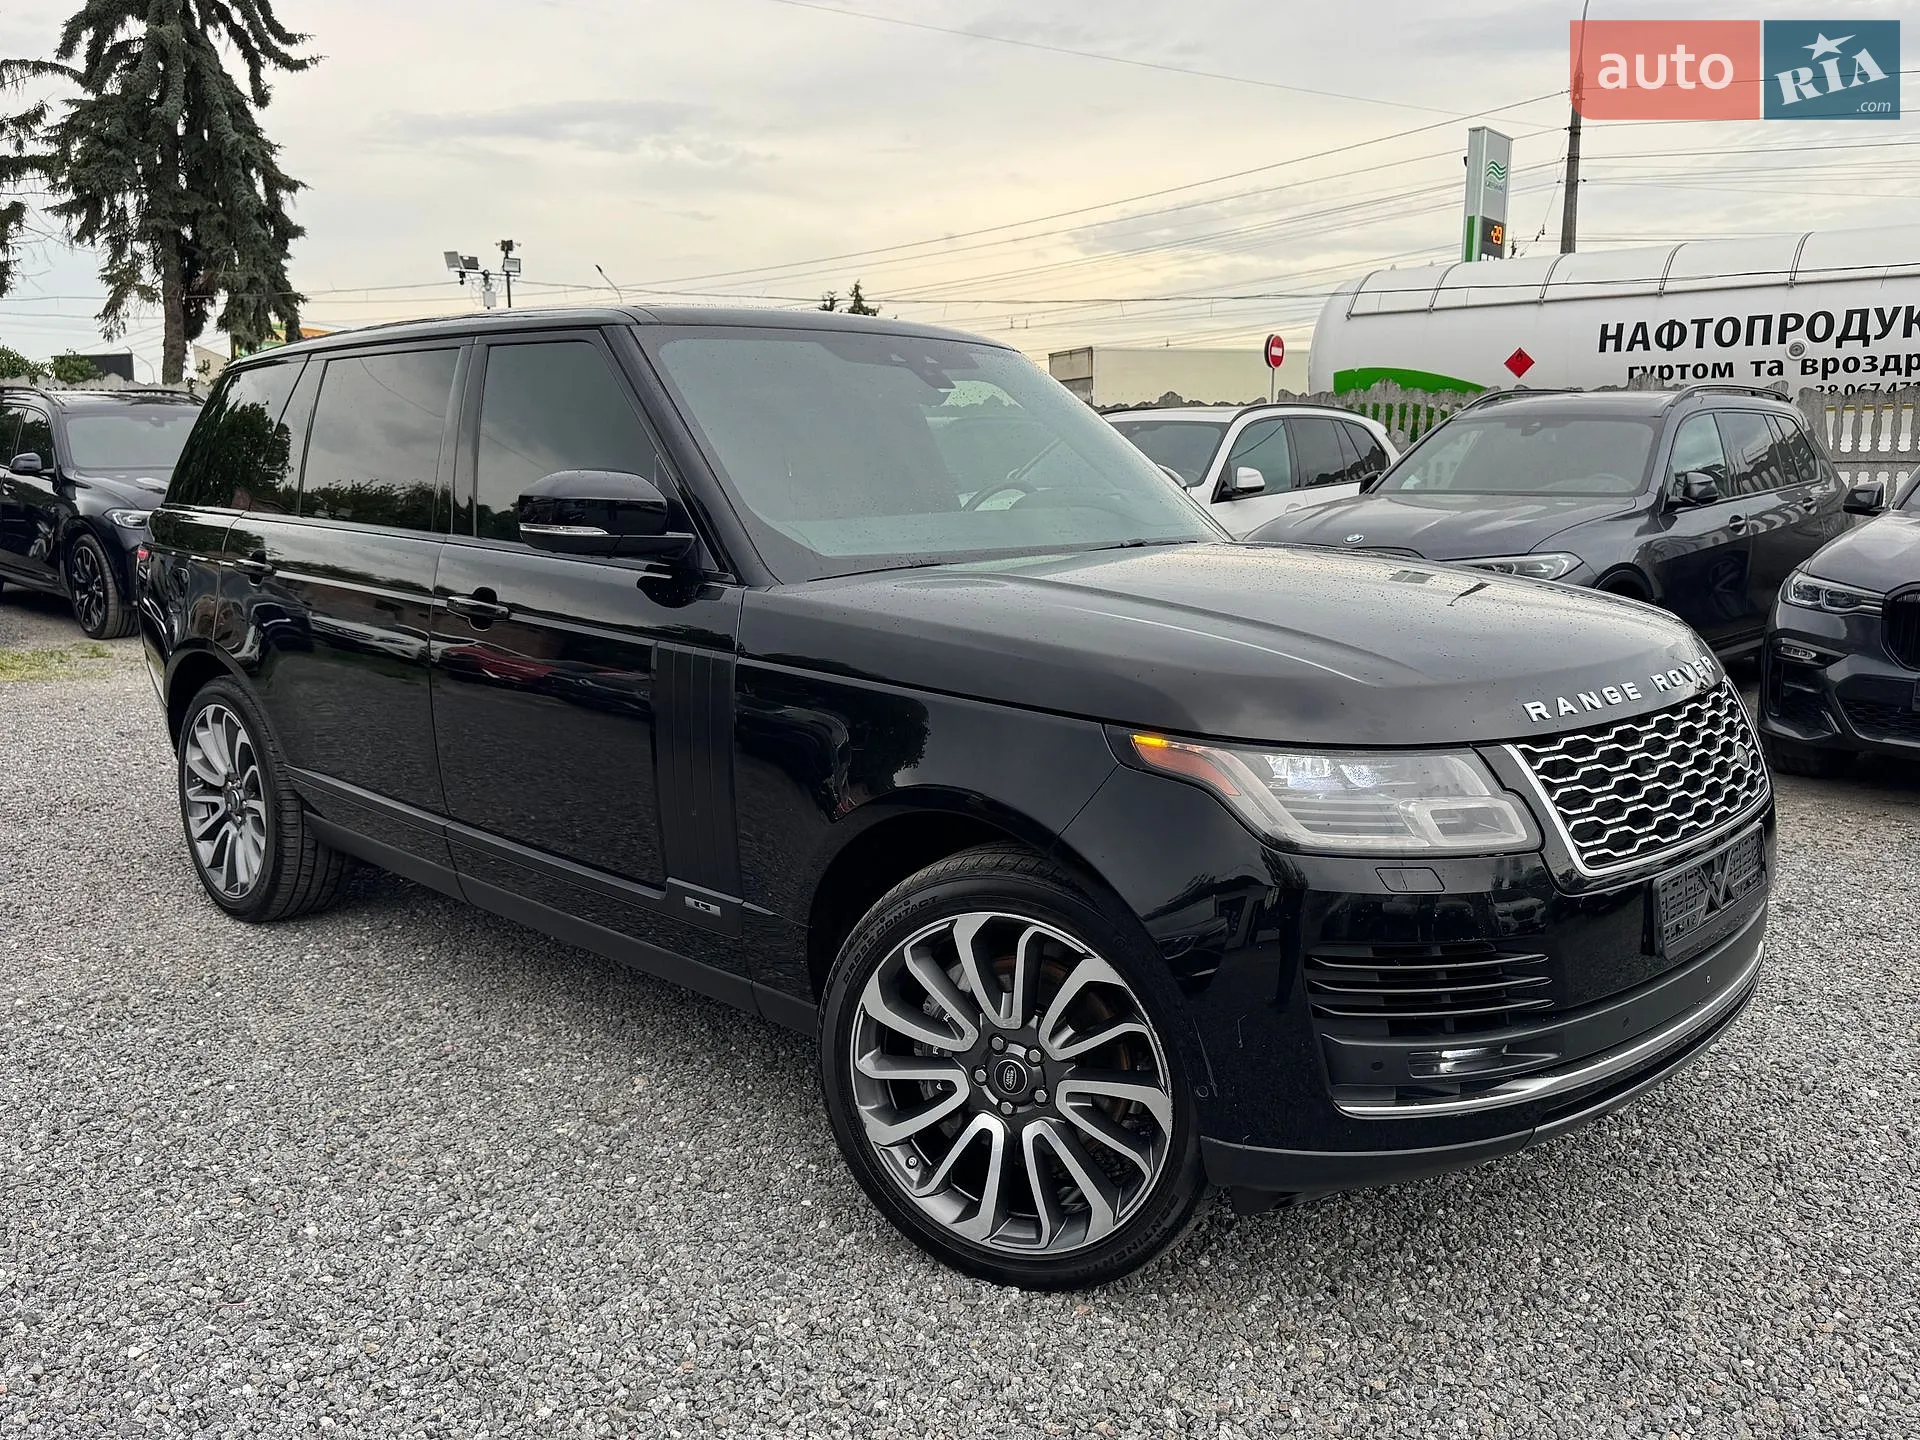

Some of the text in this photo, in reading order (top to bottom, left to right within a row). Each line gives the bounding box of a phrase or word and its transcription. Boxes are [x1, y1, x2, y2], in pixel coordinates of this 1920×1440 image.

[1598, 305, 1920, 353] НАФТОПРОДУК
[1751, 358, 1785, 378] та
[1800, 353, 1920, 381] вроздр
[1522, 655, 1716, 722] RANGE ROVER
